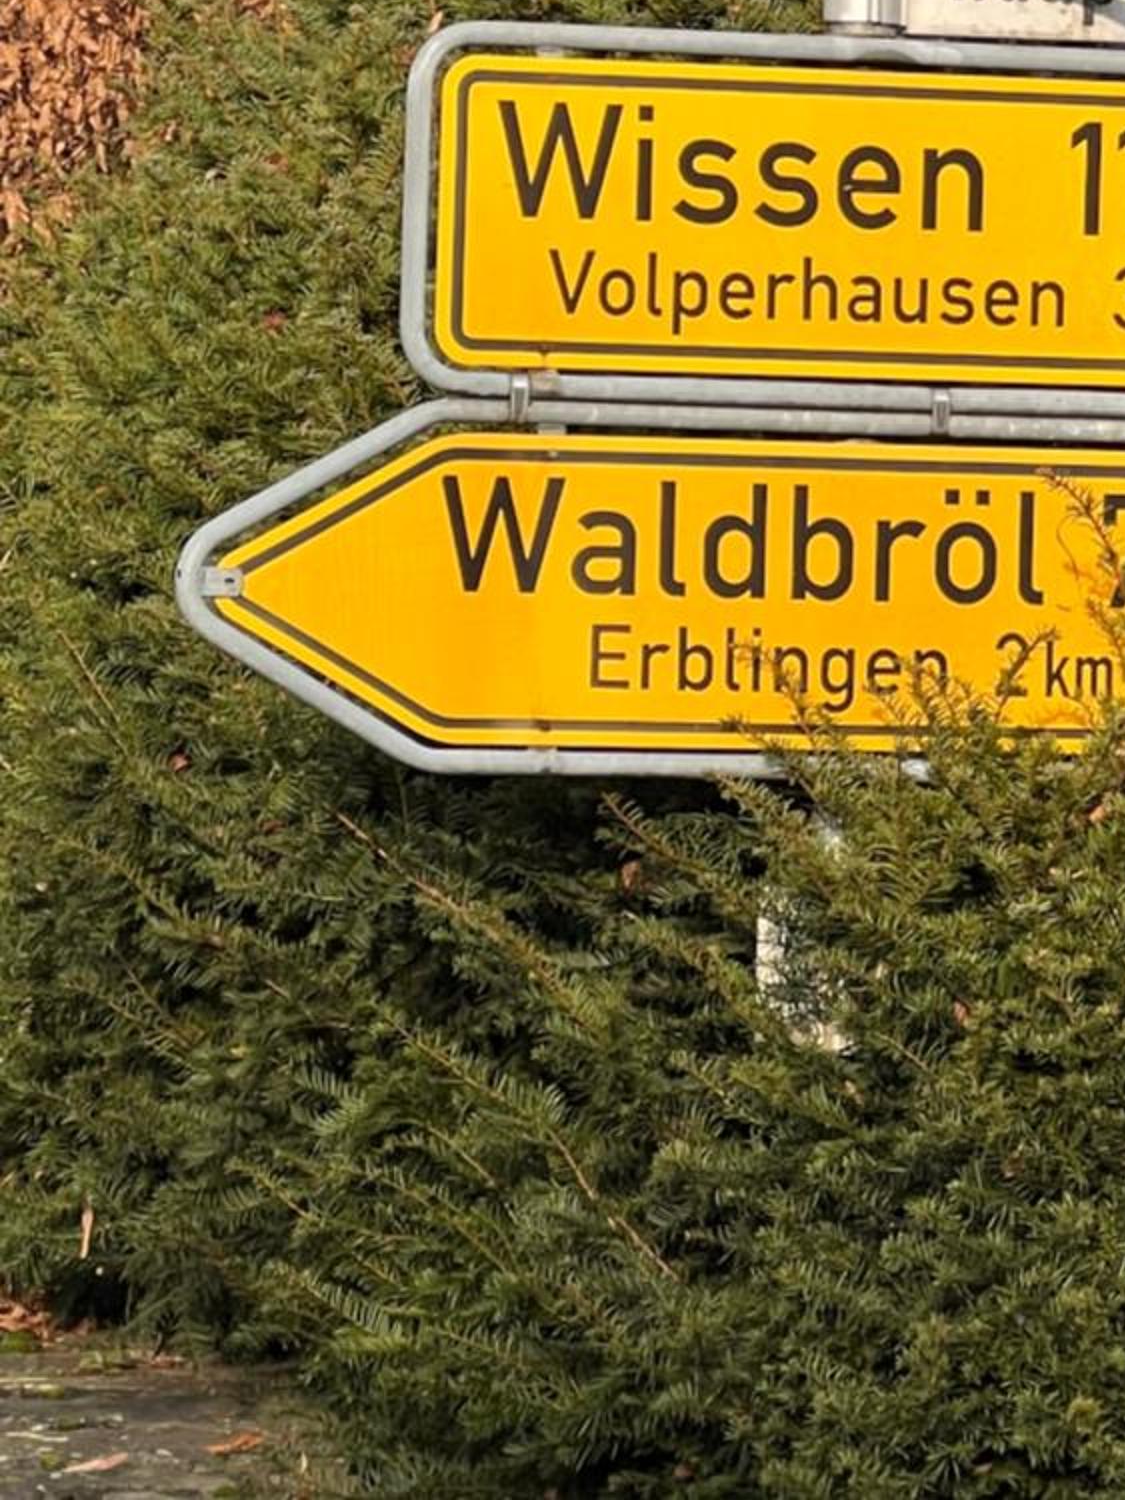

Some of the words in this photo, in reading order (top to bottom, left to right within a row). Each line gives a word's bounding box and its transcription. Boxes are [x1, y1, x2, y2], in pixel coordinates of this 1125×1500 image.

[498, 100, 984, 232] Wissen
[549, 248, 1065, 335] Volperhausen
[442, 475, 1044, 607] Waldbröl
[588, 624, 947, 712] Erblingen
